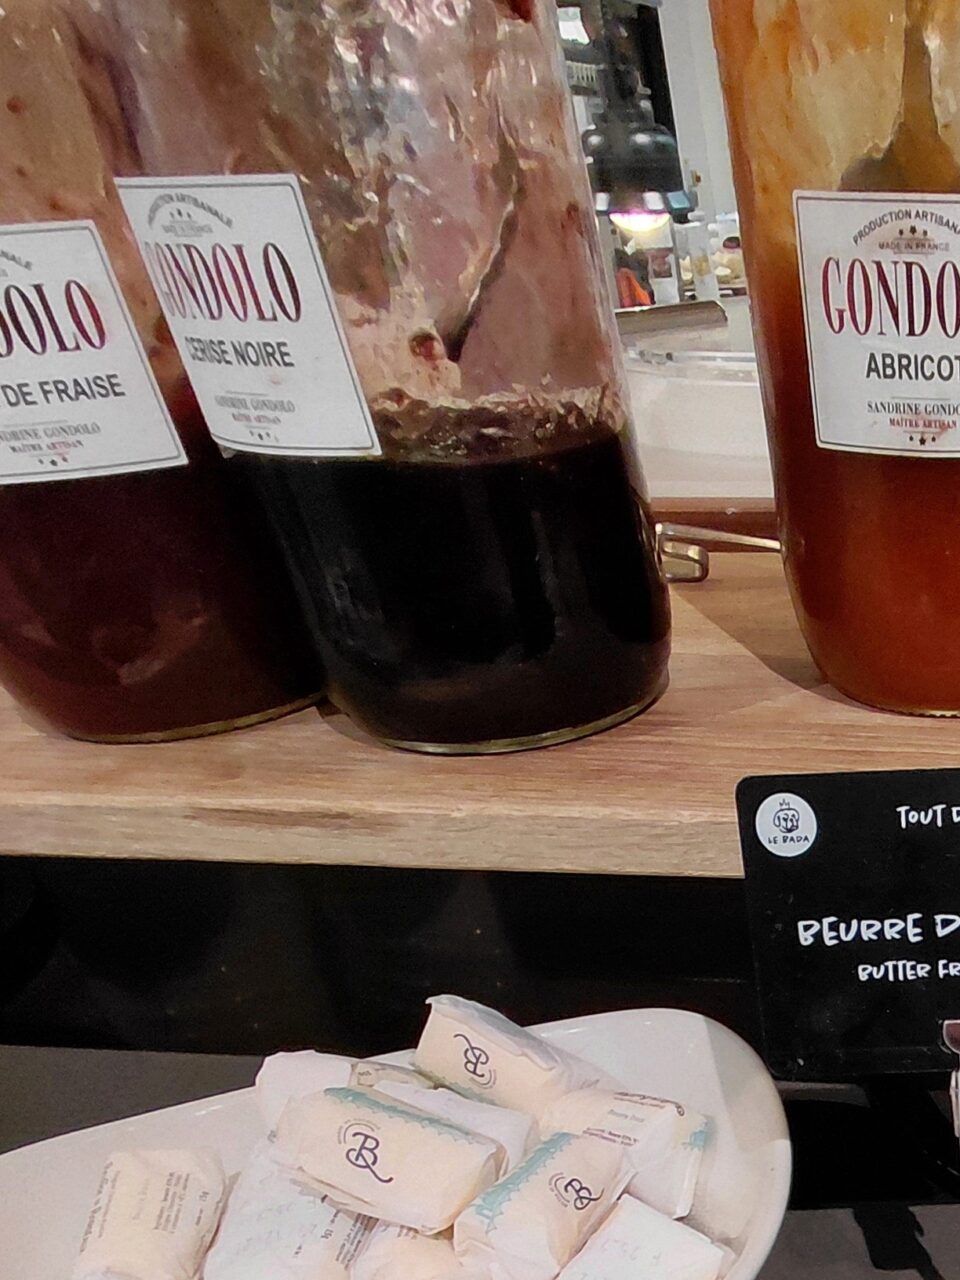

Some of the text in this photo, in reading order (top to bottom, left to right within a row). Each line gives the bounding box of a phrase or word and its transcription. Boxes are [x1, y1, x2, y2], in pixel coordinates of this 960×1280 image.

[853, 209, 912, 247] PRODUCTION
[230, 341, 295, 367] NOIRE
[1, 373, 126, 407] DE FRAISE
[867, 400, 921, 415] SANDRINE
[897, 804, 946, 829] TOUT
[797, 912, 923, 947] BEURRE
[857, 958, 930, 982] BUTTER
